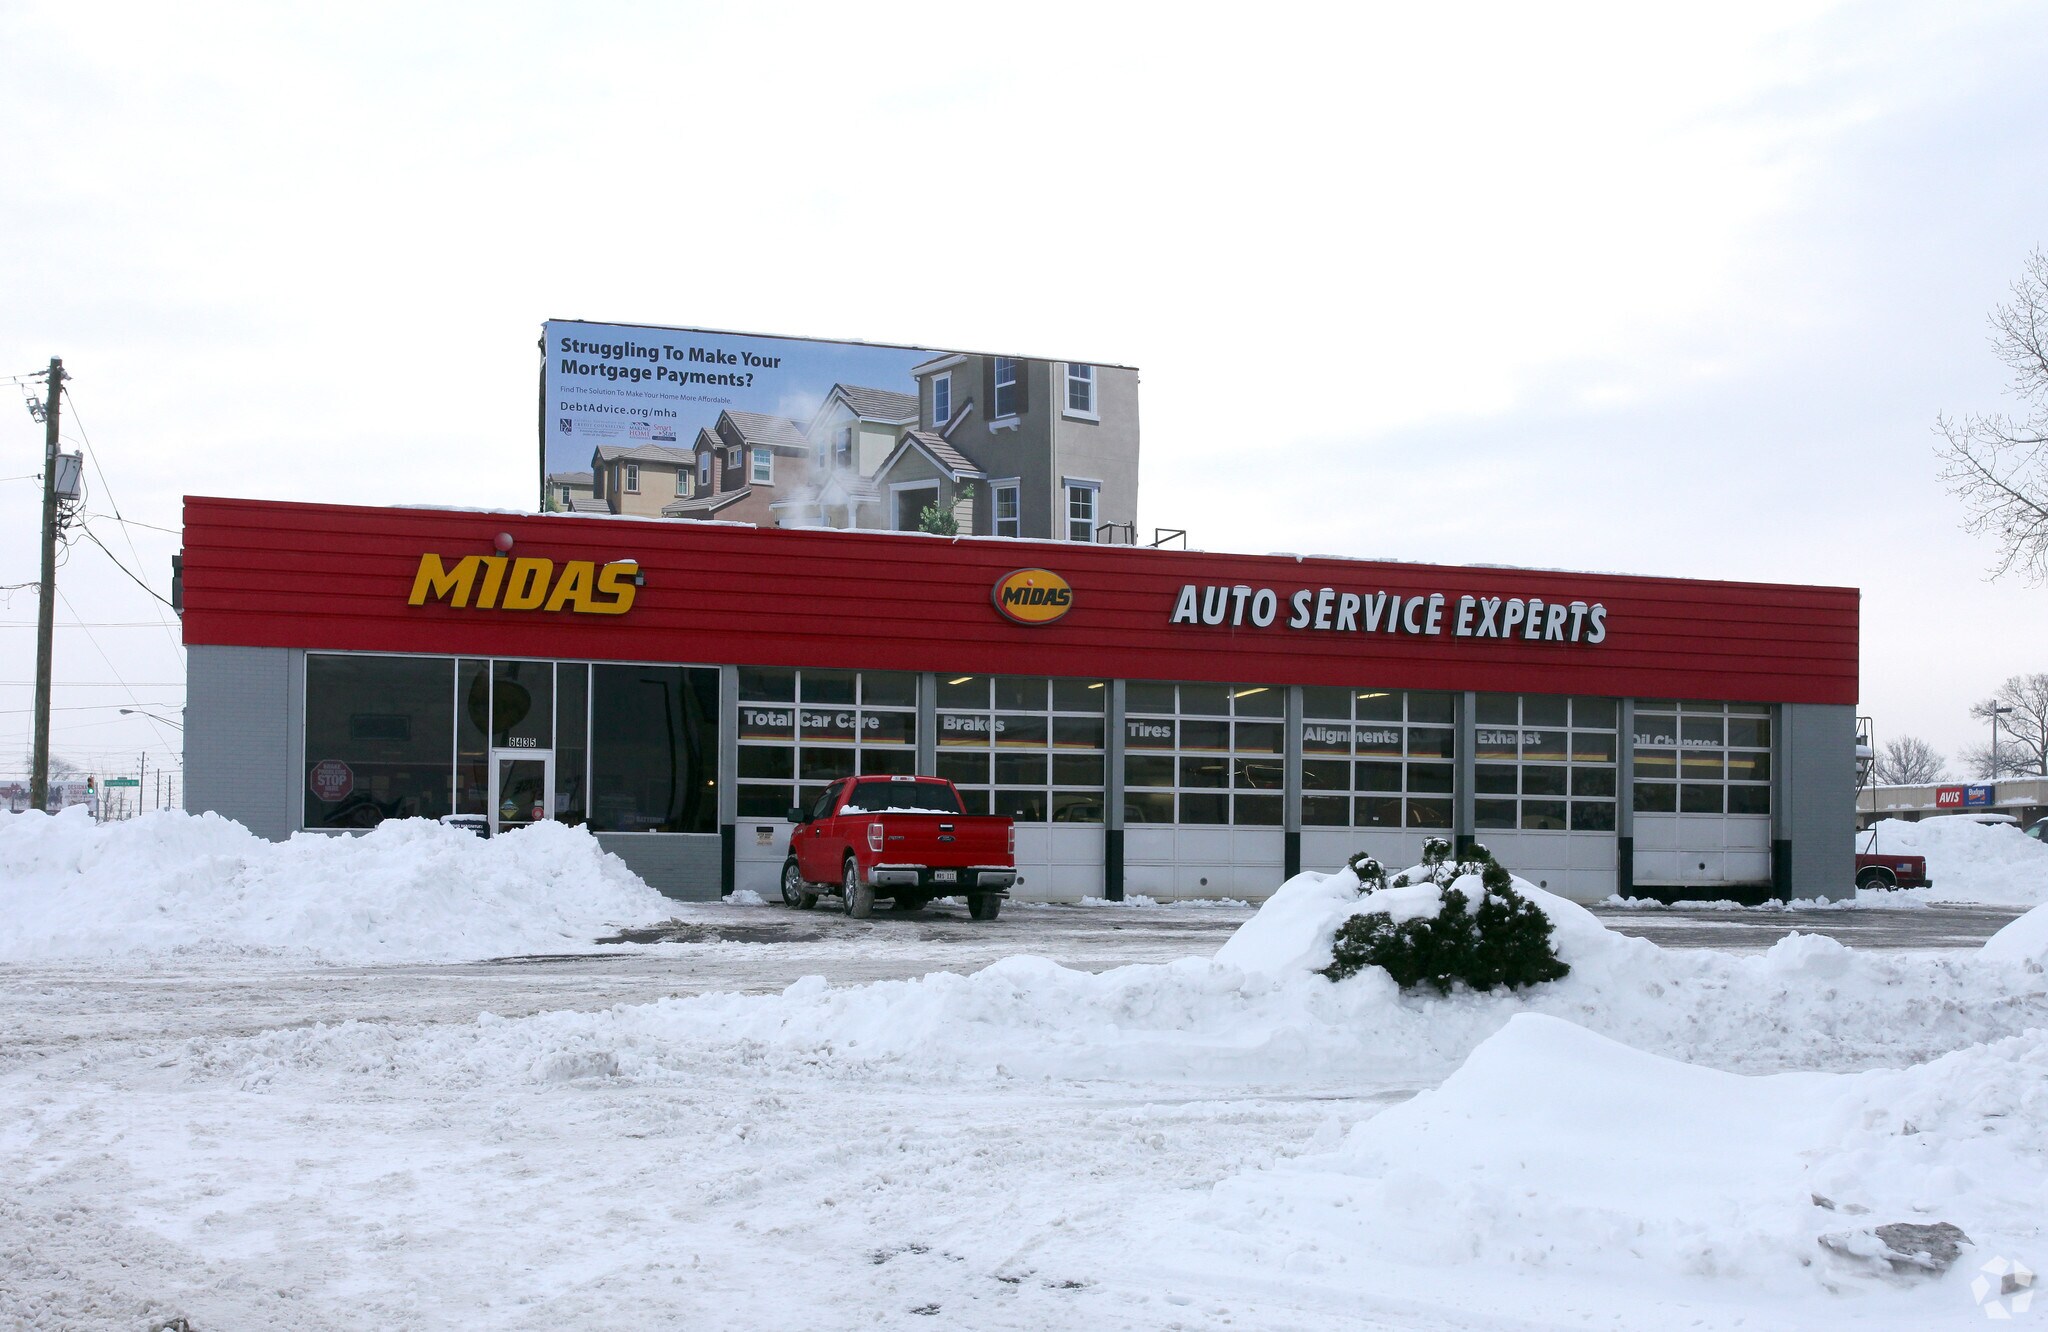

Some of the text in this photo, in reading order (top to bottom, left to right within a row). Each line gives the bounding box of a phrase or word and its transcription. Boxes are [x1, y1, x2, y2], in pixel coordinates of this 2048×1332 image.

[561, 338, 781, 368] Struggling To Make Your
[561, 359, 754, 387] Mortgage Payments?
[576, 386, 588, 394] The
[588, 387, 616, 396] Solution
[698, 395, 733, 404] Affordable.
[560, 402, 677, 418] DebtAdvice.org/mha
[407, 552, 640, 615] MIDAS
[1002, 585, 1071, 607] MIDAS
[1171, 584, 1607, 644] AUTO SERVICE EXPERTS
[744, 710, 880, 730] Total Car Care
[1127, 722, 1172, 738] Tires
[1303, 727, 1399, 744] Alignments
[509, 737, 537, 748] 6435
[317, 774, 347, 786] STOP
[1939, 791, 1960, 803] AVIS
[1968, 788, 1985, 797] Budget
